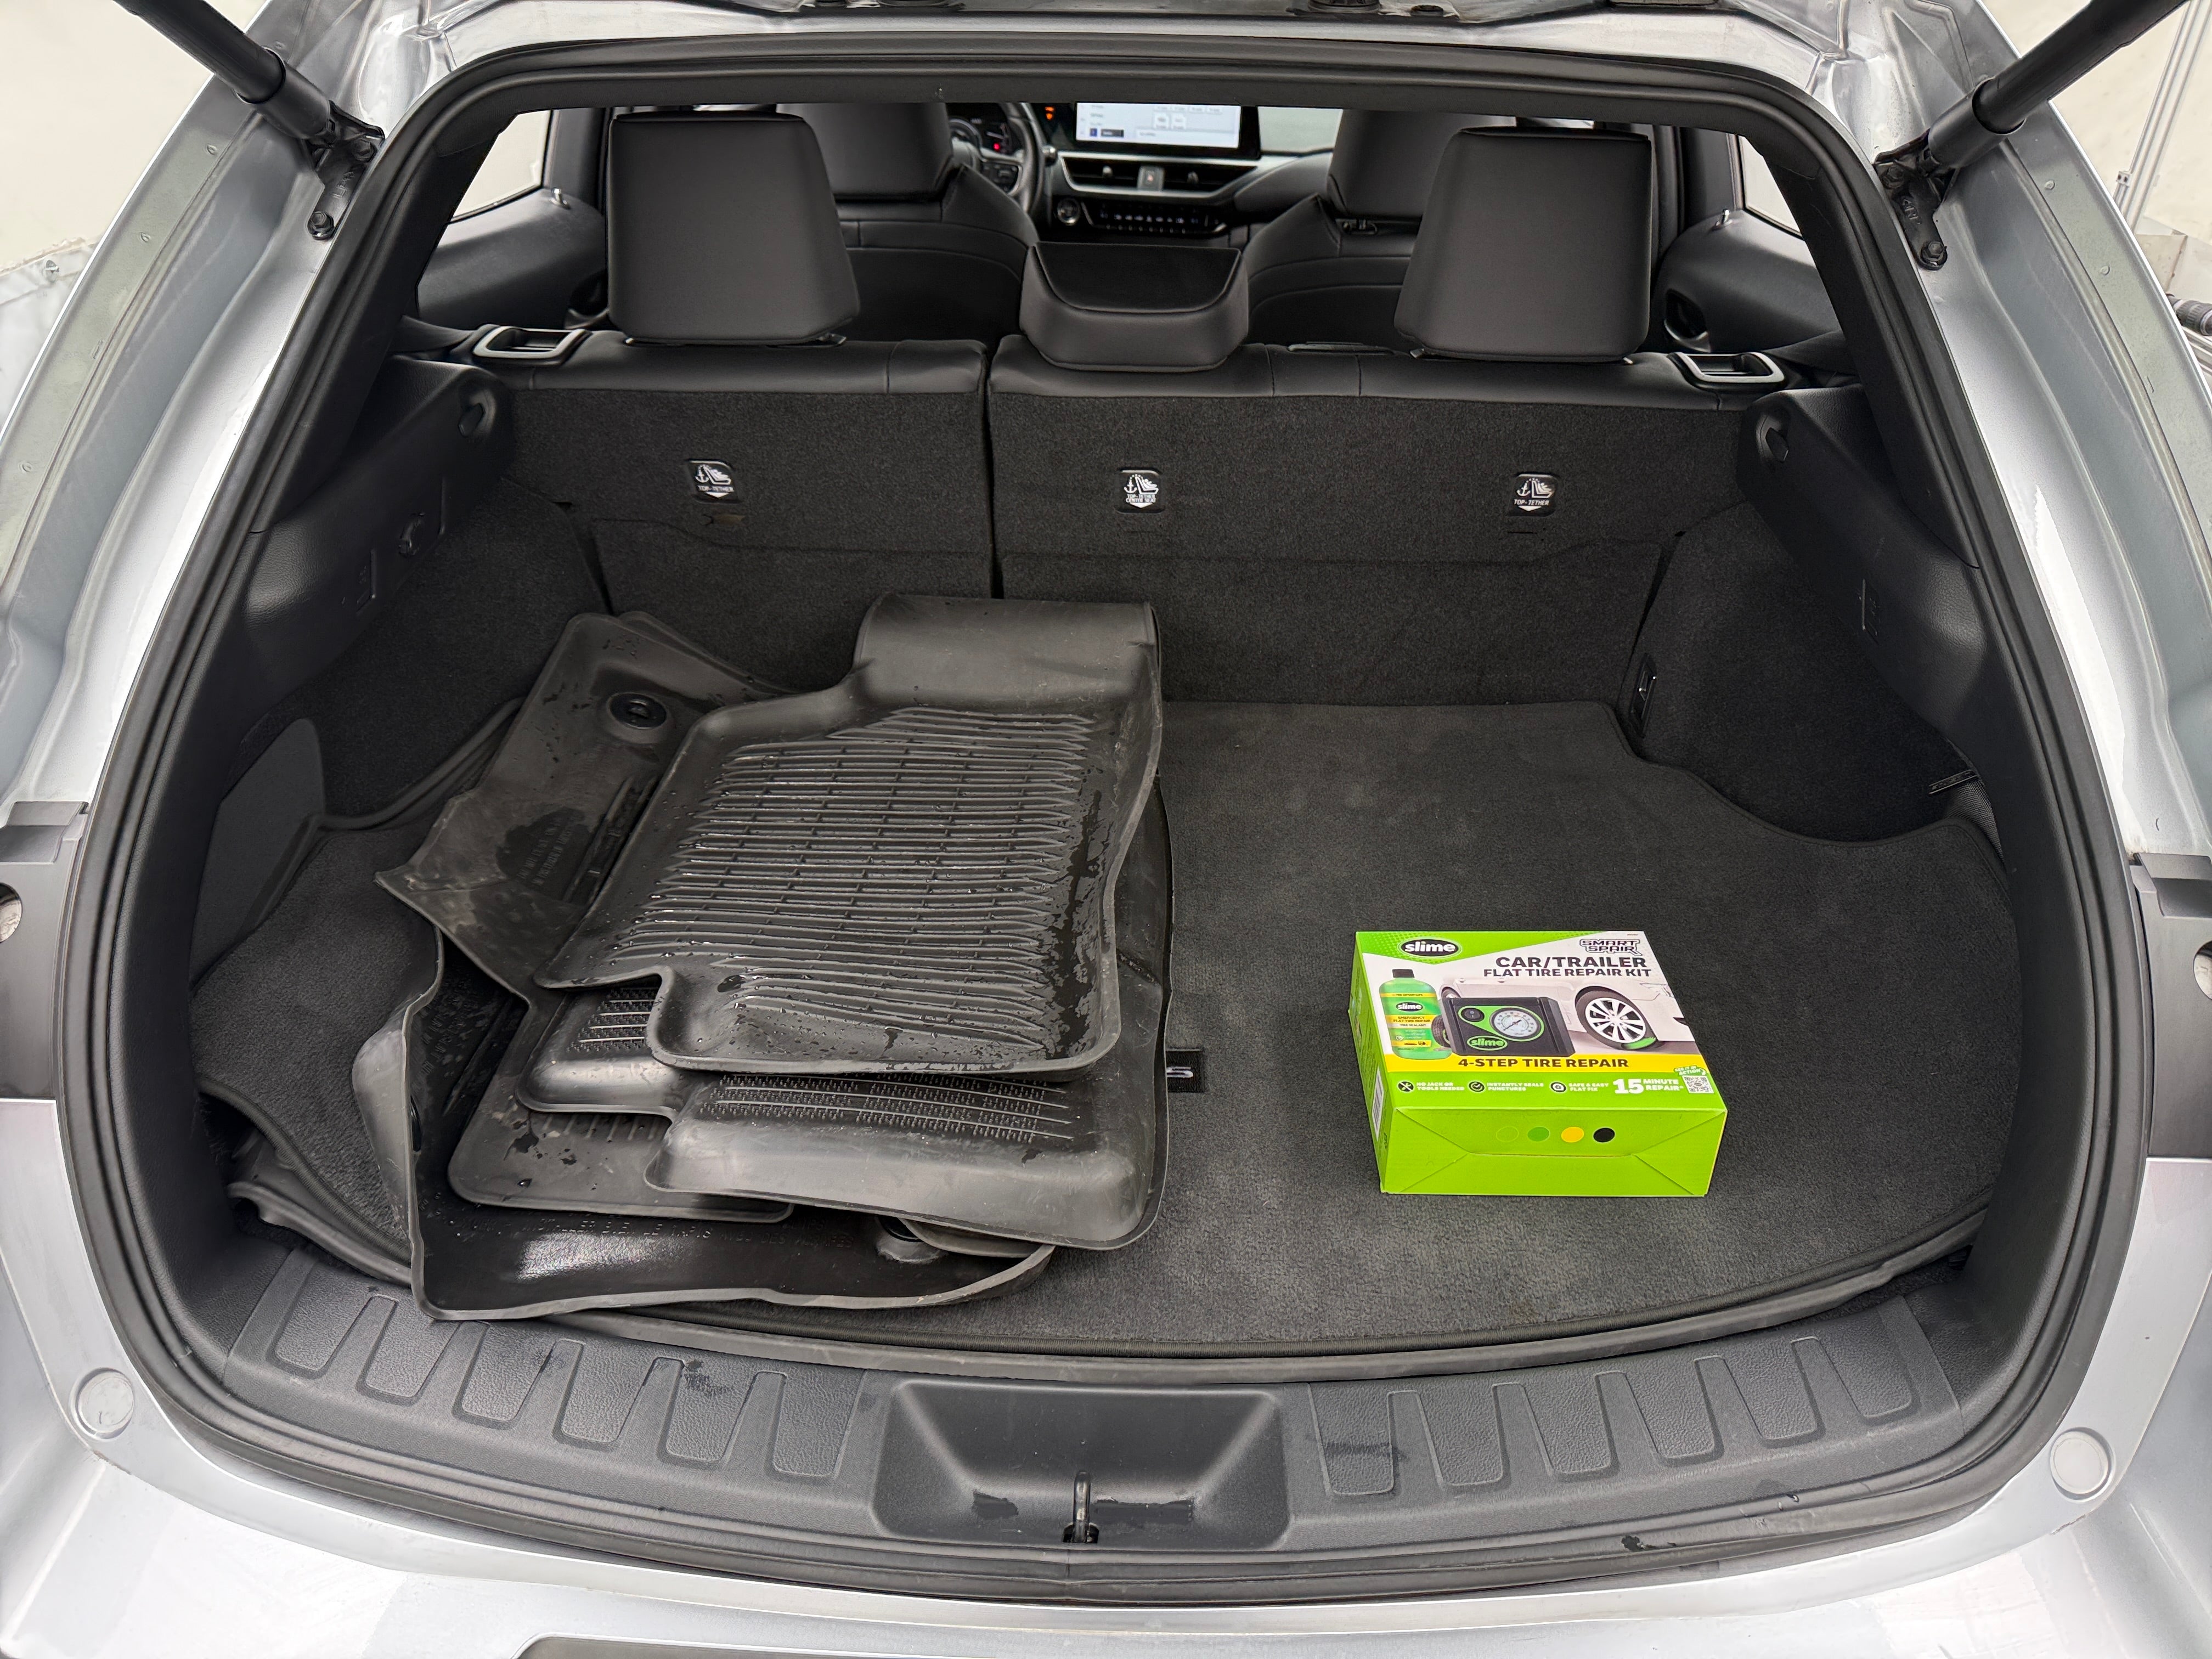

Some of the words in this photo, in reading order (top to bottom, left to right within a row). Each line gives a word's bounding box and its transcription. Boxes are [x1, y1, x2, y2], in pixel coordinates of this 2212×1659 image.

[1404, 941, 1456, 952] slime
[1496, 956, 1646, 968] CAR/TRAILER
[1484, 969, 1522, 977] FLAT
[1565, 968, 1623, 977] REPAIR
[1626, 969, 1652, 977] KIT
[1471, 1038, 1505, 1046] slime
[1458, 1058, 1518, 1068] 4-STEP
[1522, 1059, 1562, 1068] TIRE
[1565, 1059, 1629, 1068] REPAIR
[1613, 1079, 1644, 1094] 15
